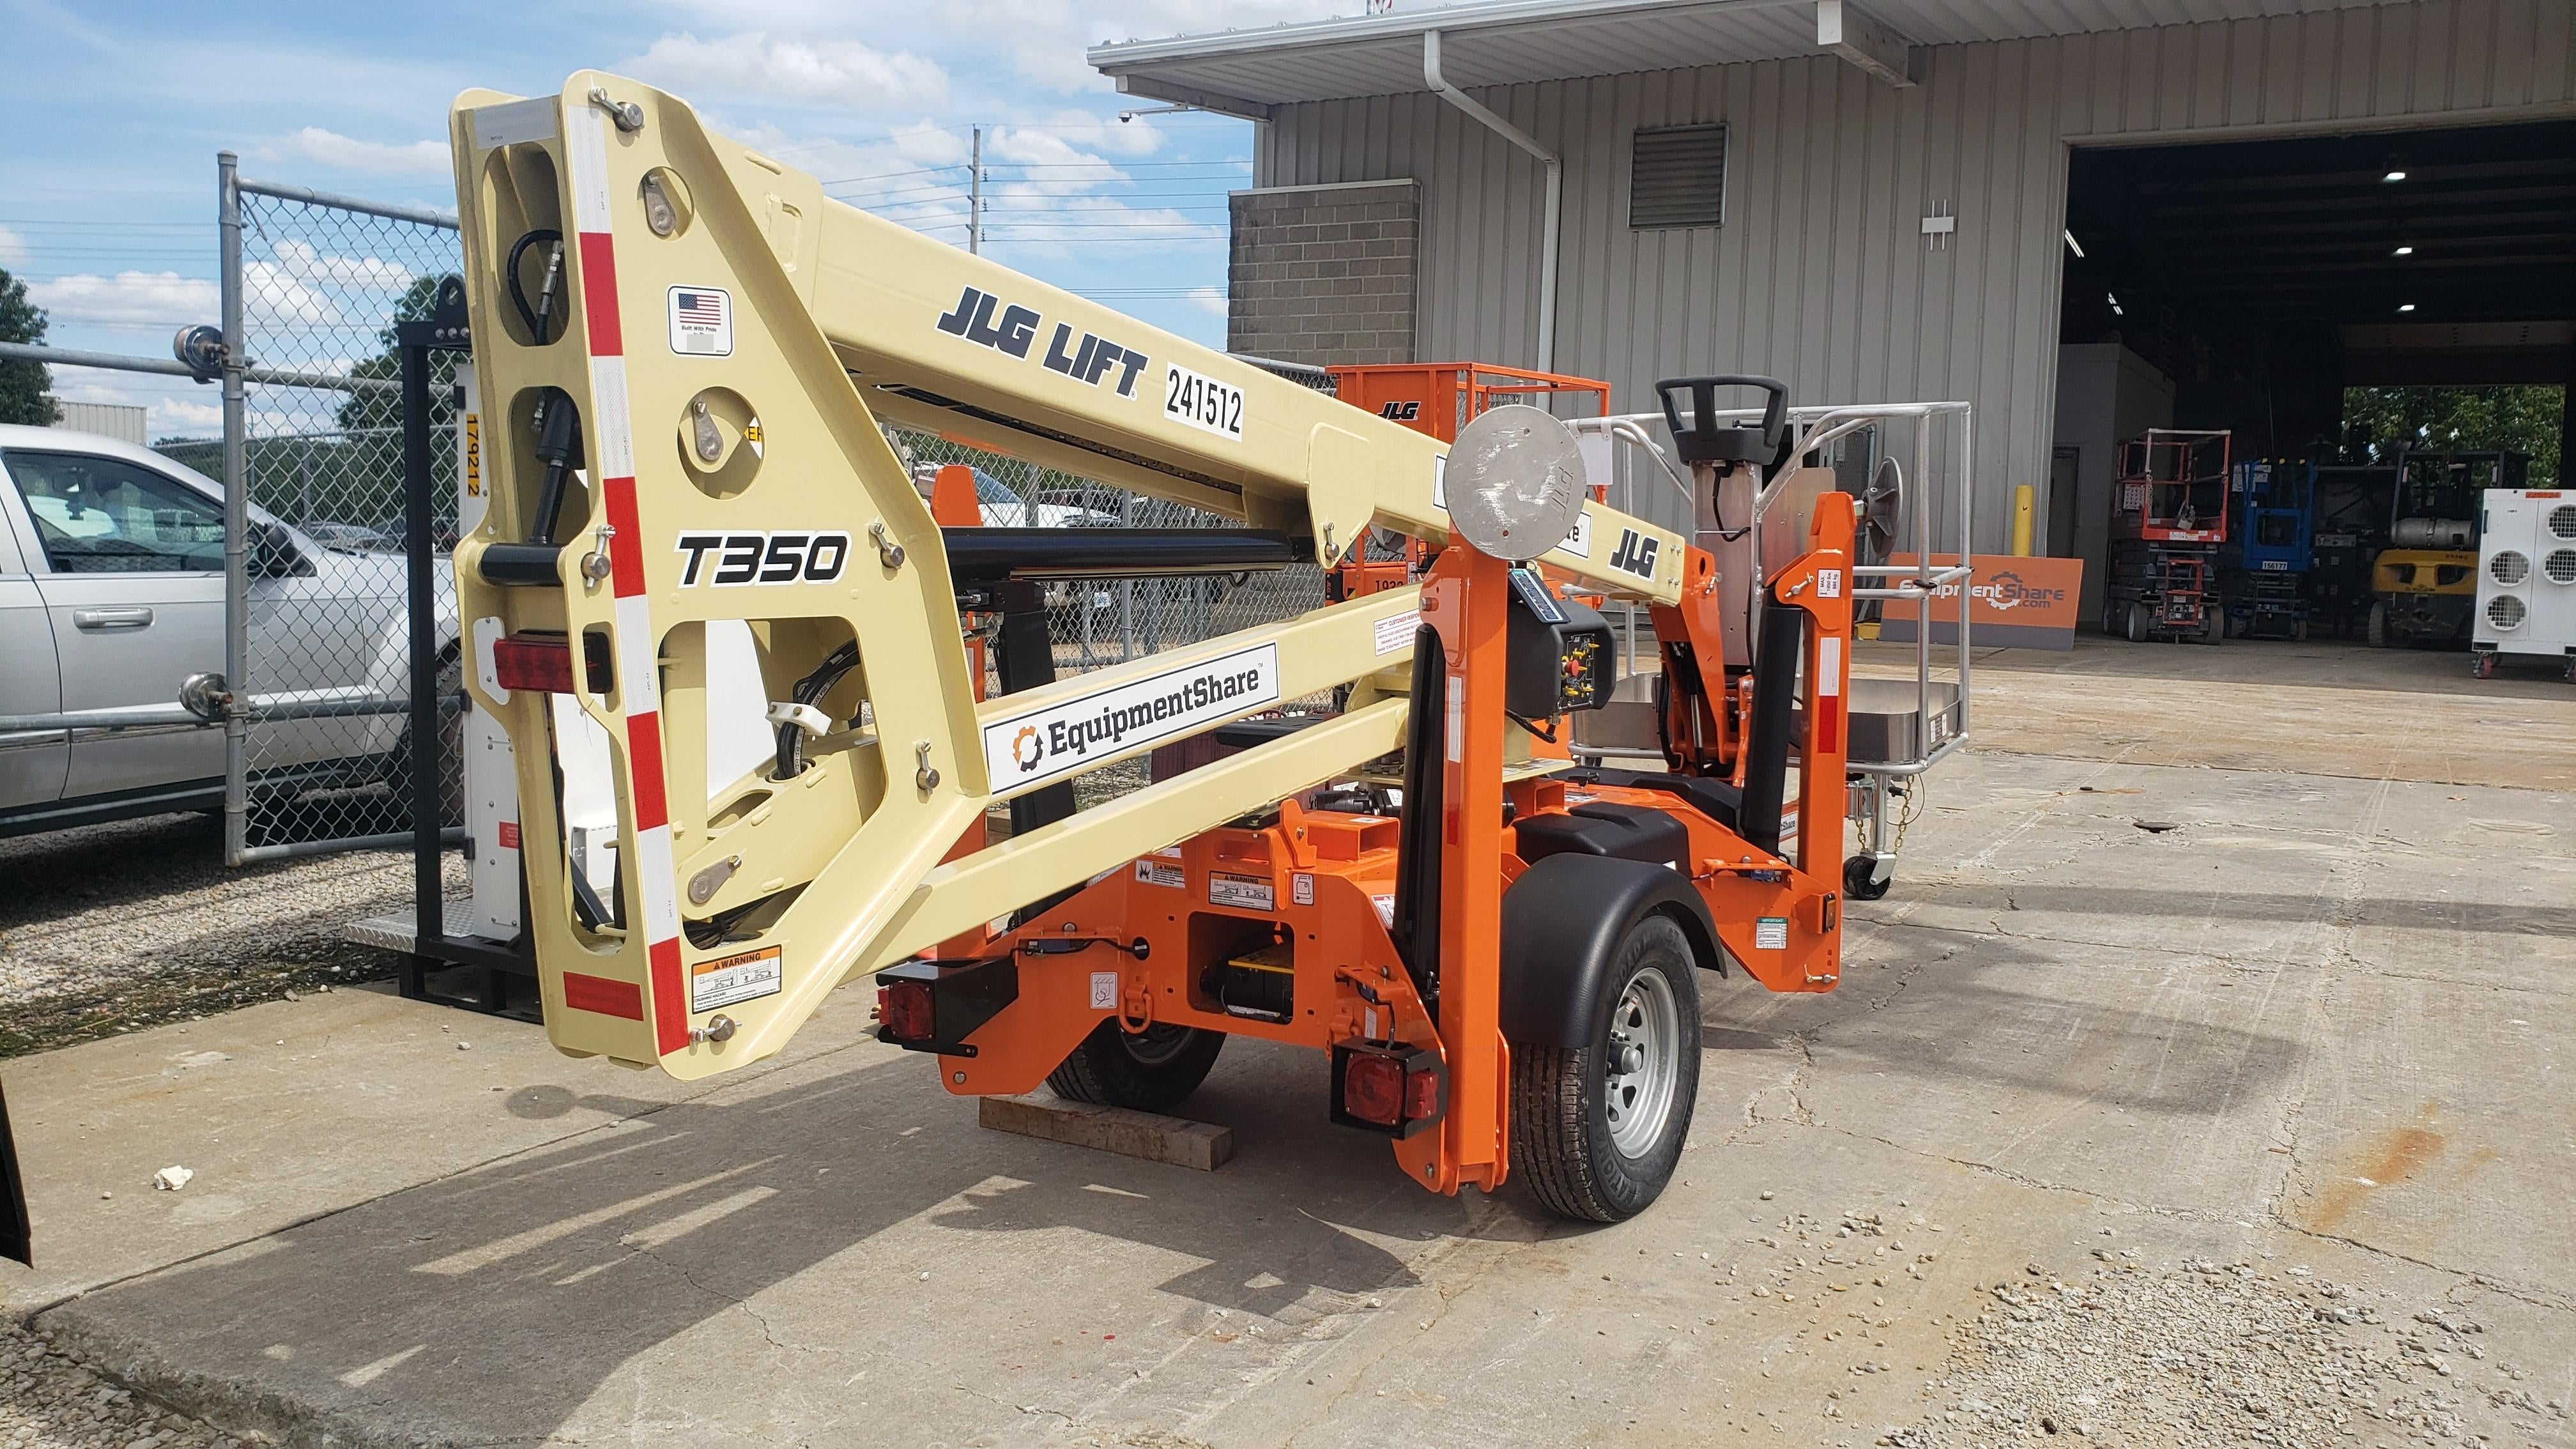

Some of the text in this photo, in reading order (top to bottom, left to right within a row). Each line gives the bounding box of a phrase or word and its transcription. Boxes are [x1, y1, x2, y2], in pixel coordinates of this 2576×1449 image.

[937, 286, 1149, 397] JLG LIFT
[1167, 369, 1241, 434] 241512
[1377, 402, 1420, 420] JLG
[467, 415, 479, 496] 179212
[678, 536, 848, 585] T350
[1609, 528, 1659, 579] JLG
[1048, 668, 1259, 756] EquipmentShare
[1229, 875, 1259, 884] WARNING
[721, 953, 761, 969] WARNING
